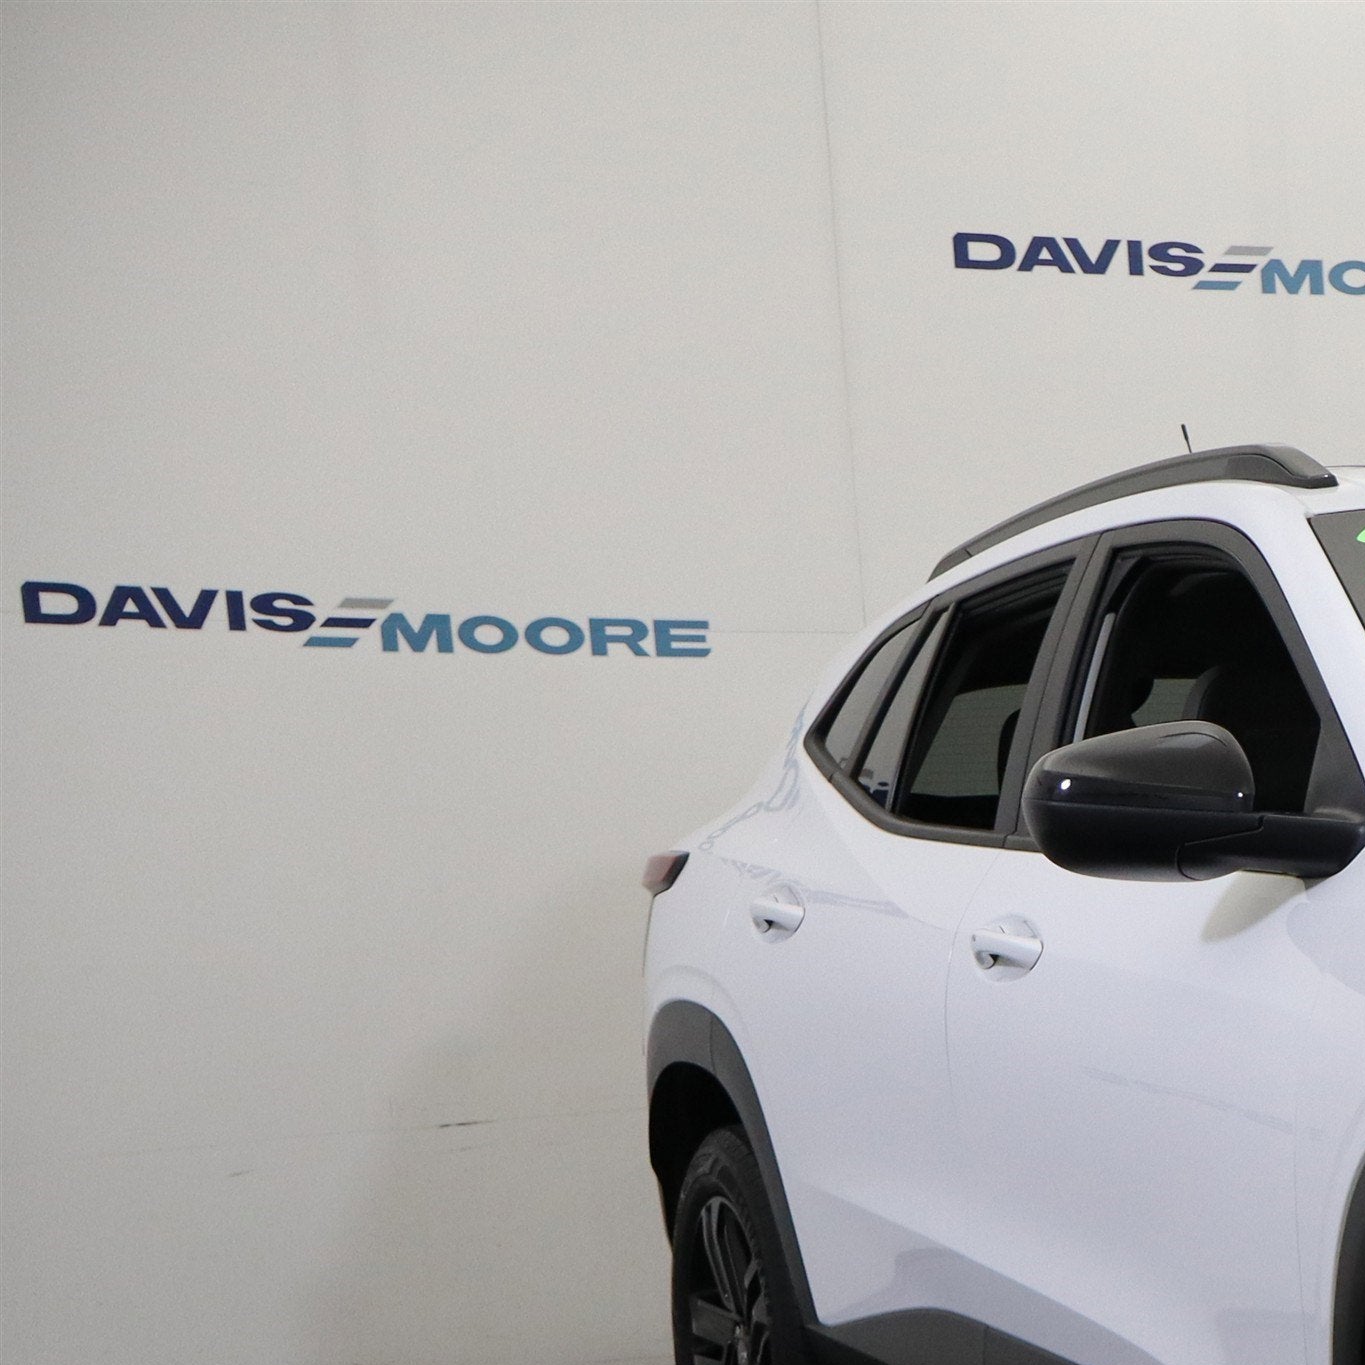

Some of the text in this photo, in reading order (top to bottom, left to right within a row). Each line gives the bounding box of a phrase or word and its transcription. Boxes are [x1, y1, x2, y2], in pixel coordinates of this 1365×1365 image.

[951, 232, 1205, 277] DAVIS
[20, 581, 712, 659] DAVIS MOORE
